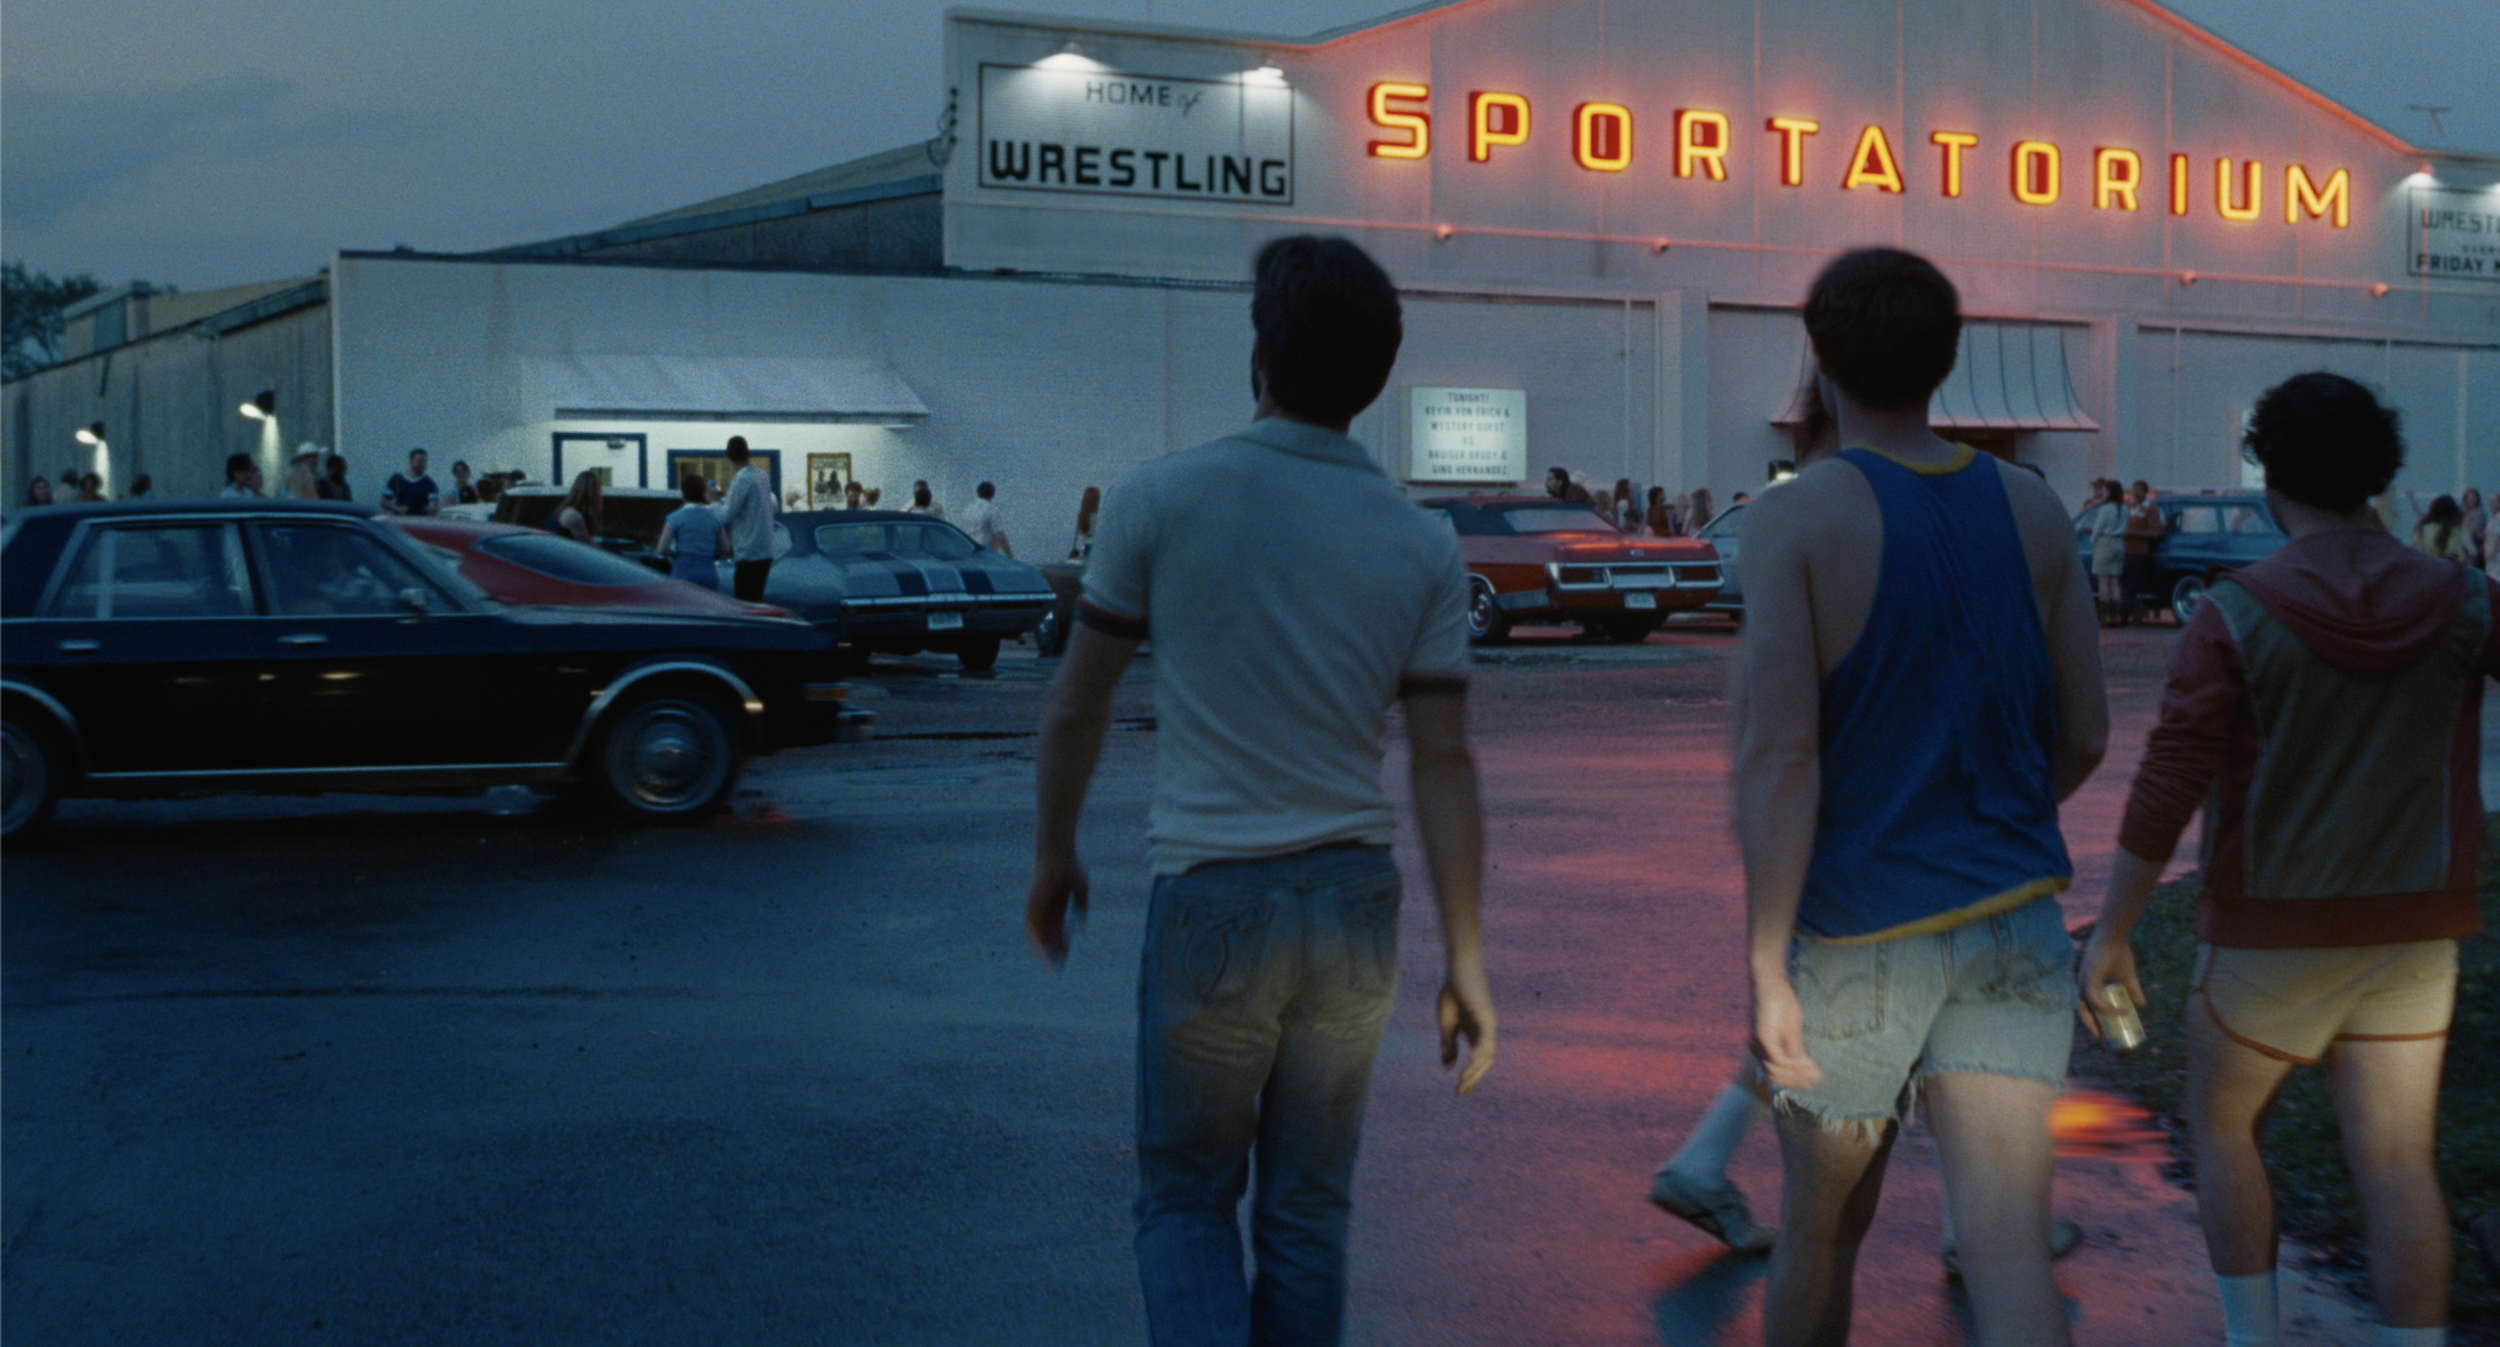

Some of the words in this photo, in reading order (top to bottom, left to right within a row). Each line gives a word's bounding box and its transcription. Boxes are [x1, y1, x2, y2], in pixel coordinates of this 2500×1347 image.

[1085, 80, 1171, 107] HOME
[1175, 90, 1203, 117] of
[1367, 82, 2350, 230] SPORTATORIUM
[989, 139, 1287, 197] WRESTLING
[2417, 253, 2484, 272] FRIDAY
[1425, 405, 1451, 416] KEVIN
[1455, 406, 1472, 416] VON
[1431, 421, 1474, 432] MYSTERY
[1477, 422, 1505, 432] GUEST
[1428, 449, 1465, 460] BRUISER
[1432, 464, 1453, 475] GINO
